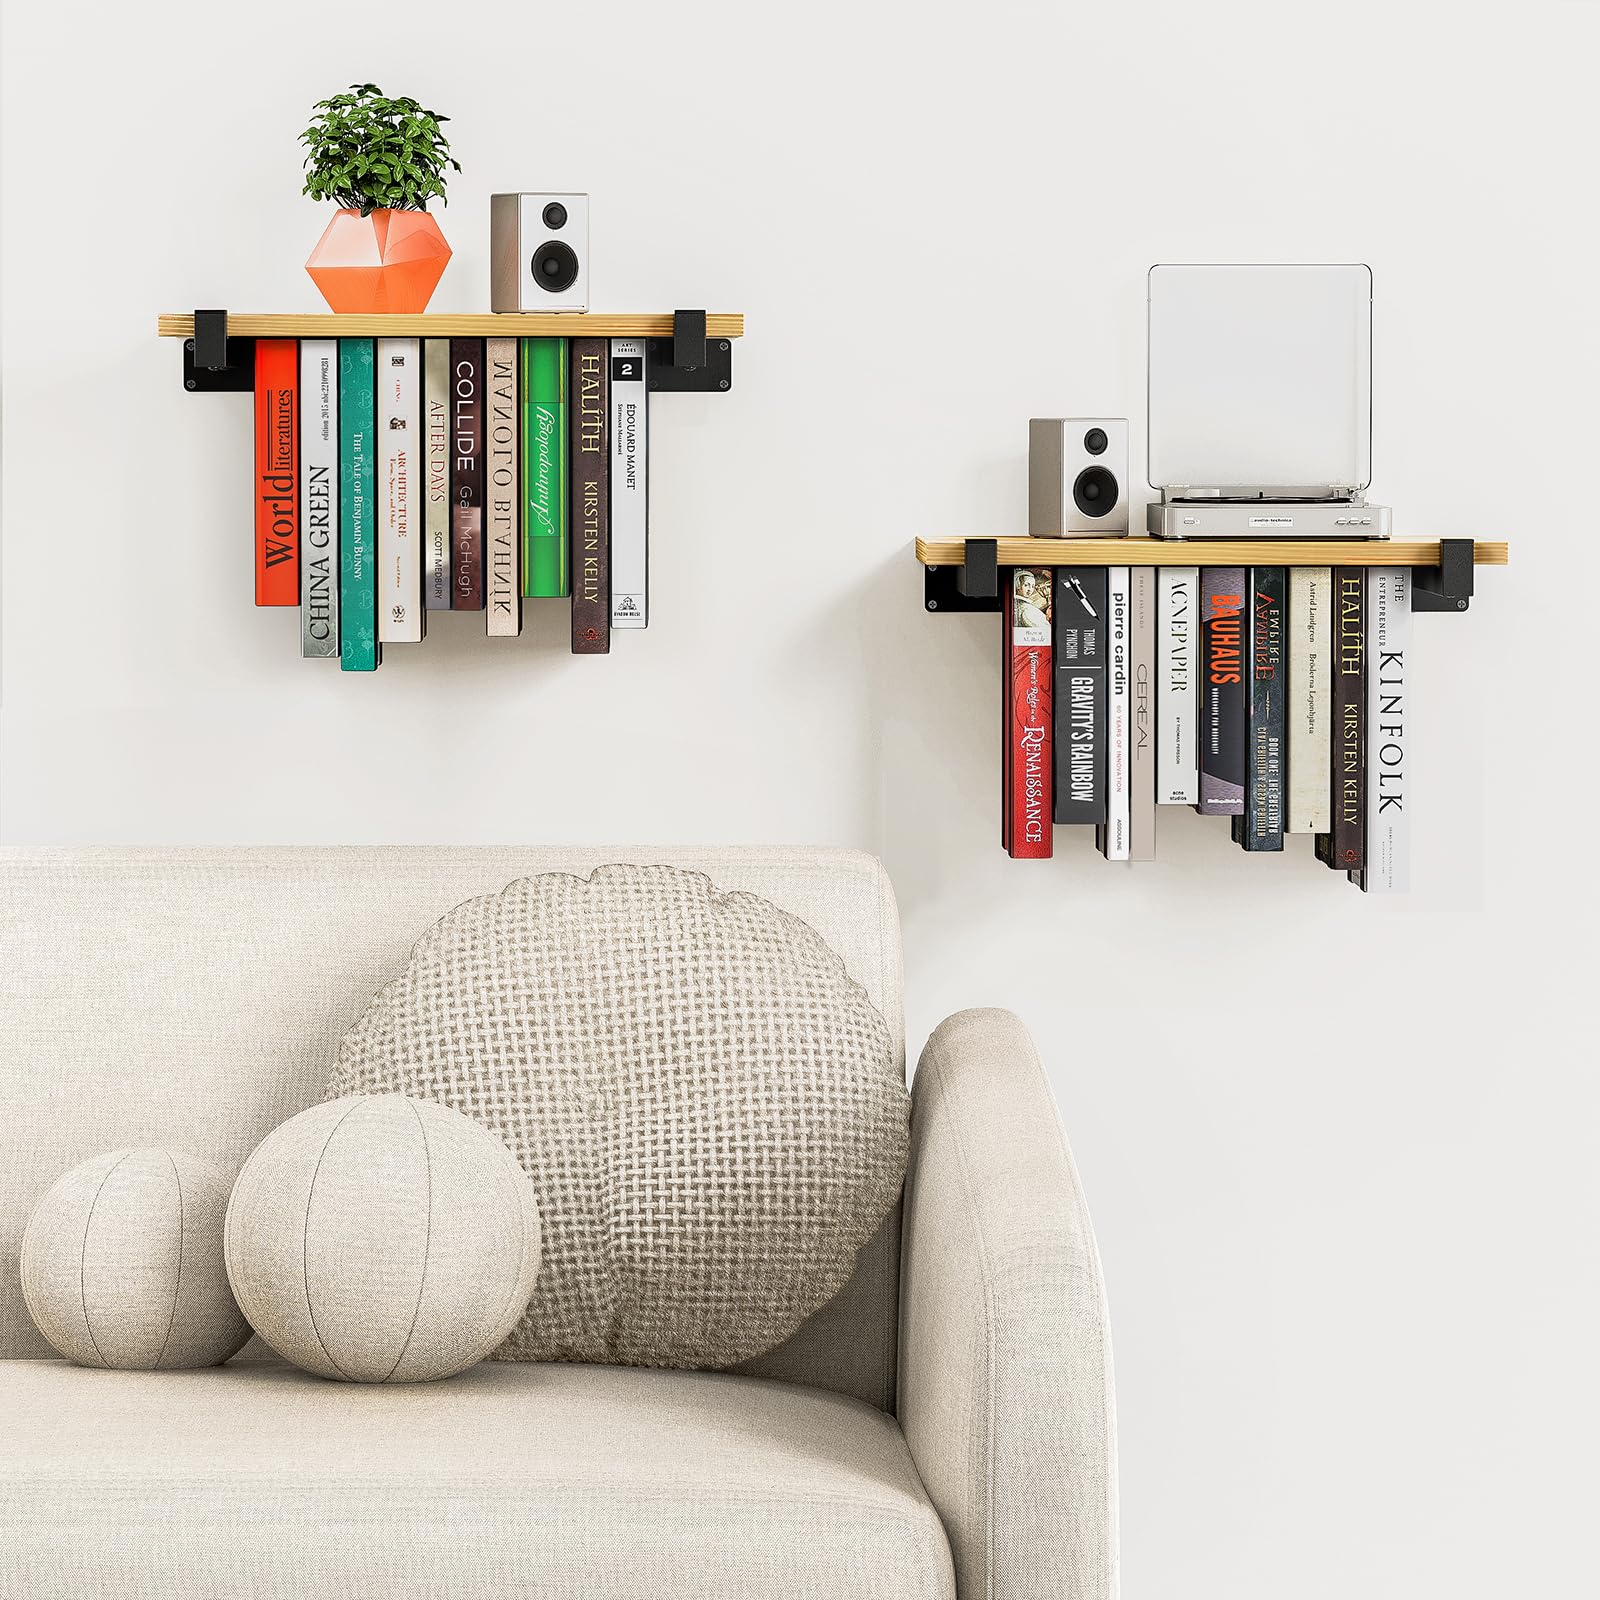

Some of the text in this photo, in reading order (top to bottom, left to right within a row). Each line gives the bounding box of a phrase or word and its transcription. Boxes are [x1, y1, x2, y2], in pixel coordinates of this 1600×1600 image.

[621, 363, 633, 376] 2
[273, 390, 291, 471] literatures
[321, 405, 329, 418] 2015
[321, 421, 329, 440] edition
[354, 432, 363, 452] THE
[354, 454, 363, 479] TALE
[430, 400, 445, 502] AFTER DAYS
[456, 361, 475, 597] COLLIDE Gail McHugh
[530, 406, 556, 534] Anthropology
[627, 404, 637, 490] ÉDOUARD MANET
[263, 474, 294, 568] World
[352, 496, 363, 544] BENJAMIN
[398, 448, 407, 538] ARCHITECTURE
[584, 481, 598, 551] KIRSTEN
[309, 465, 330, 640] CHINA GREEN
[354, 546, 363, 580] BUNNY
[434, 531, 442, 600] SCOTT MEDBURY
[584, 557, 598, 603] KELLY
[1307, 581, 1317, 643] Astrid Lindgren
[1395, 575, 1404, 601] THE
[1028, 651, 1039, 685] Women's
[1065, 629, 1078, 659] PYNCHON
[1083, 629, 1096, 655] THOMAS
[1113, 593, 1126, 695] pierre cardin
[1170, 578, 1188, 692] ACNEPAPER
[1210, 595, 1241, 684] BAUHAUS
[1027, 686, 1039, 708] Roles
[1136, 664, 1148, 760] CEREAL
[1307, 653, 1317, 735] Bröderna Lejonhjärta
[1071, 676, 1094, 802] GRAVITY'S RAINBOW
[1116, 740, 1122, 748] OF
[1344, 703, 1357, 772] KIRSTEN
[1378, 650, 1404, 814] KINFOLK
[1021, 726, 1045, 843] RENAISSANCE
[1344, 779, 1357, 826] KELLY
